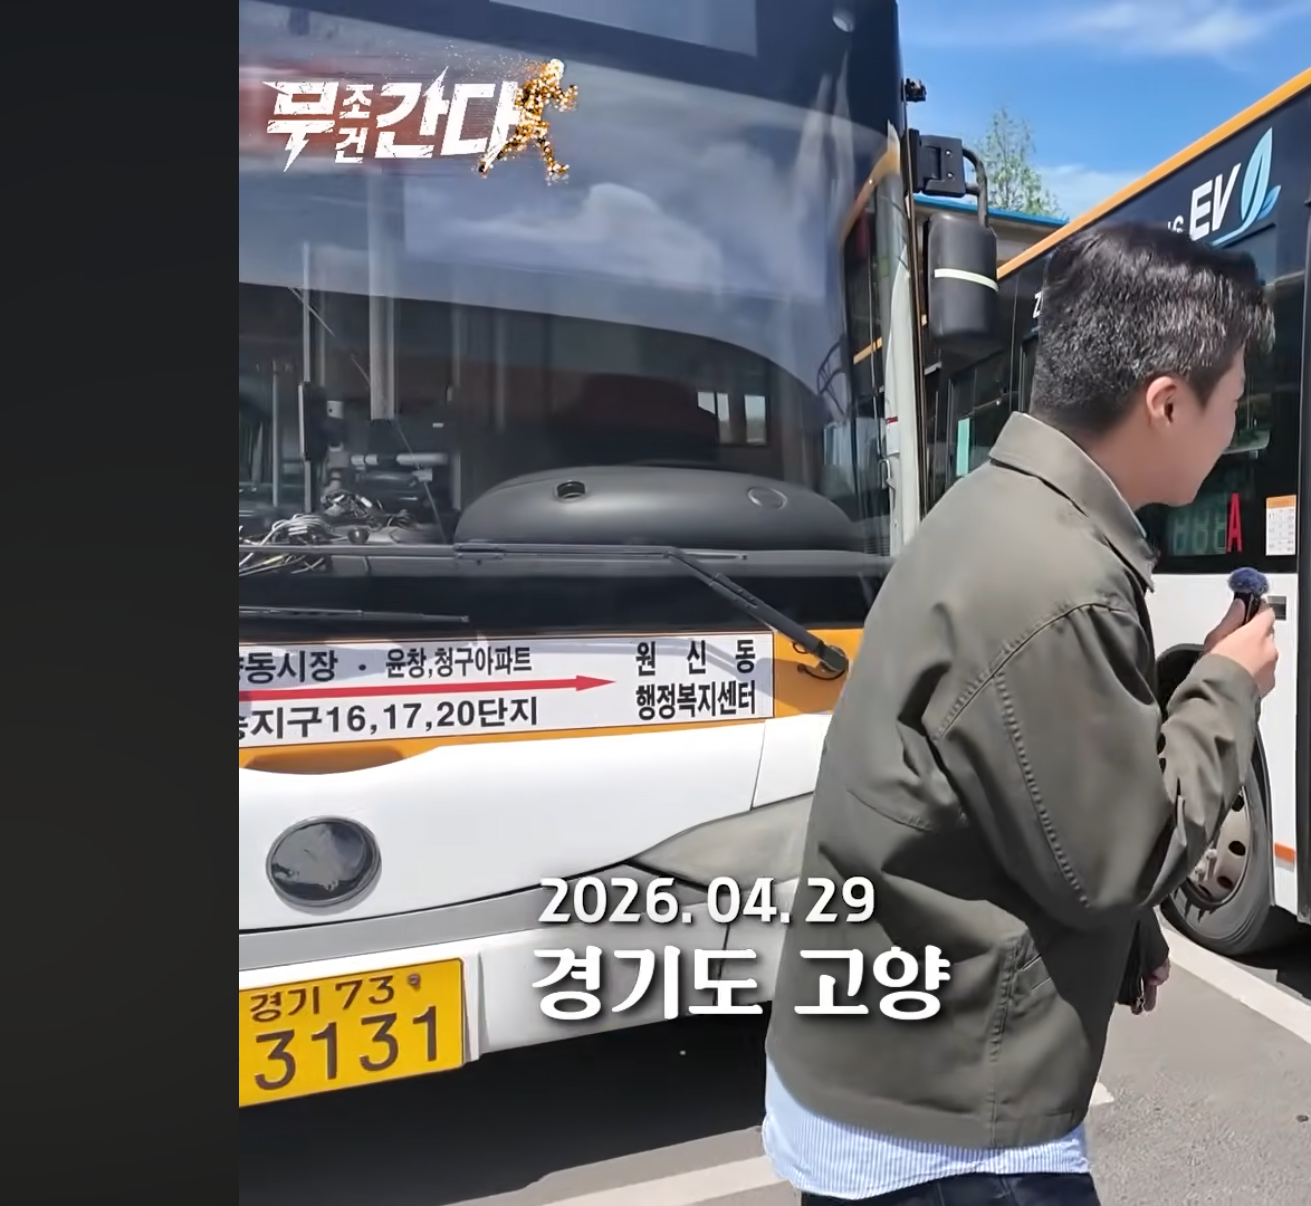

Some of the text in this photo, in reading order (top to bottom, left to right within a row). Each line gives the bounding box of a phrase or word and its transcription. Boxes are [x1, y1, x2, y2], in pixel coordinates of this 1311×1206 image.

[1189, 163, 1242, 242] EV
[635, 679, 756, 721] 행정복지센터
[250, 974, 396, 1023] 경기 73
[254, 1004, 438, 1092] 3131
